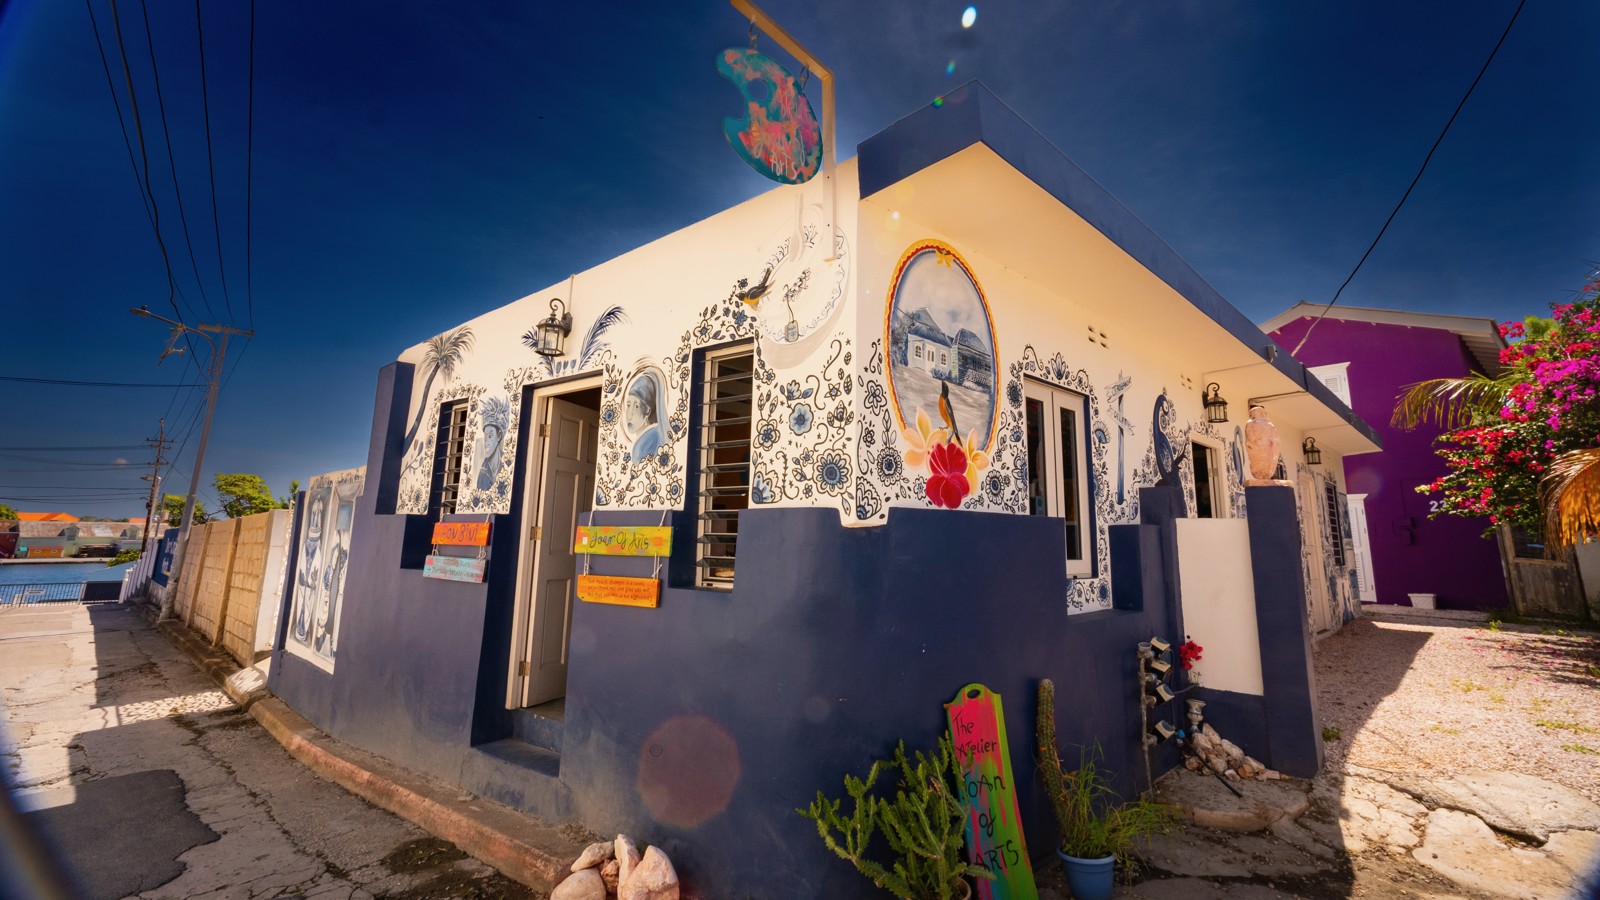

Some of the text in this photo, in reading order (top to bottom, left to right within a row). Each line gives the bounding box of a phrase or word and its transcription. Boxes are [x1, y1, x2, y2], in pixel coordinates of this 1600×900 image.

[952, 709, 975, 737] The
[978, 807, 997, 838] of
[974, 839, 1020, 873] ARTS
